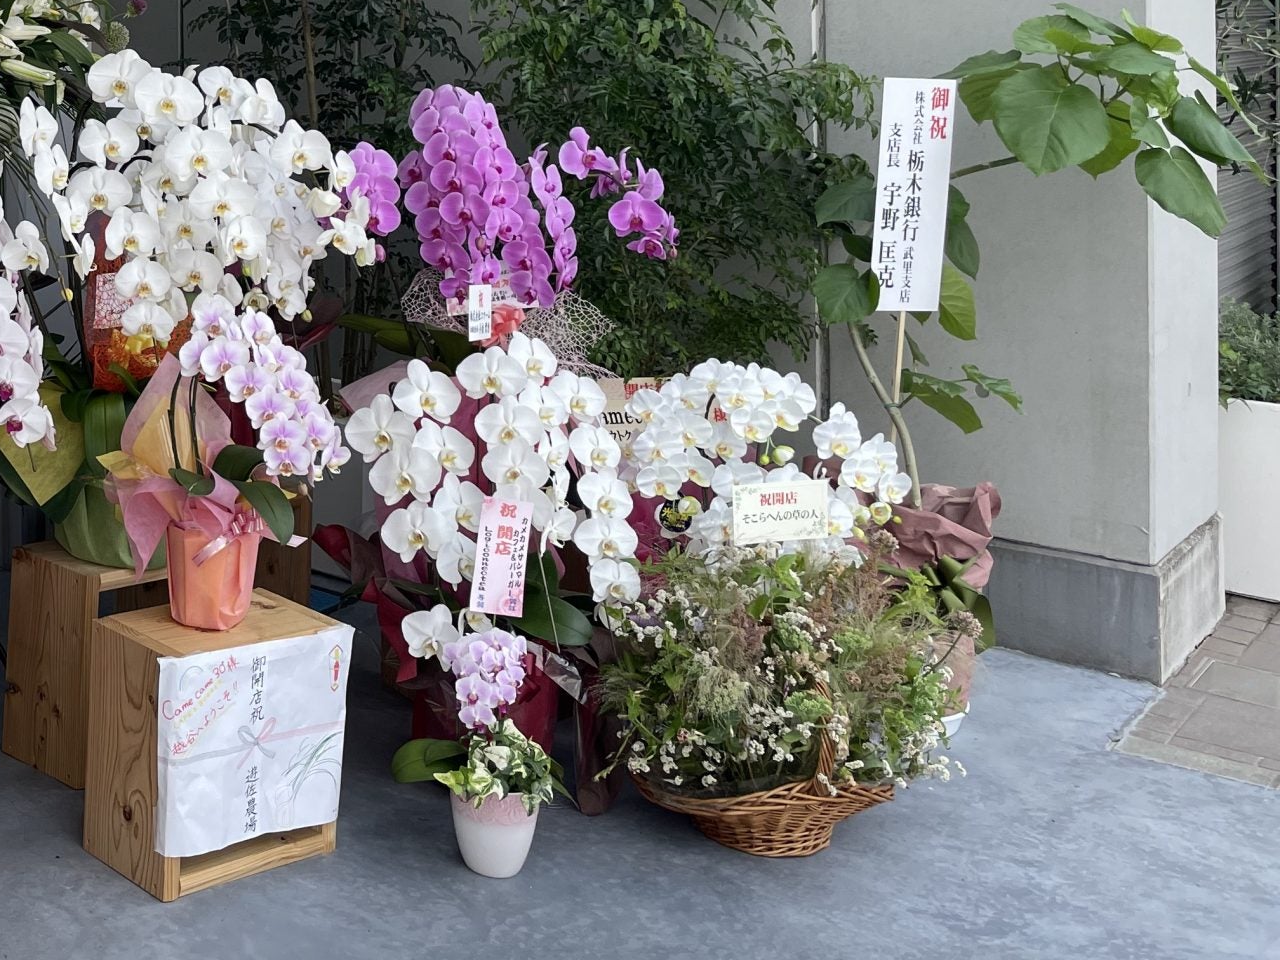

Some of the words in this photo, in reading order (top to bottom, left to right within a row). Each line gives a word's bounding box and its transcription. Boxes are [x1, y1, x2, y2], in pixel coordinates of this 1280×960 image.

[913, 91, 926, 144] 株式会社
[930, 87, 950, 139] 御祝
[886, 122, 903, 168] 支店長
[901, 149, 925, 242] 栃木銀行
[899, 246, 915, 303] 武里支店
[742, 508, 819, 524] そこらへんの草の人
[760, 491, 798, 507] 祝開店
[249, 655, 267, 726] 御開店祝
[244, 765, 260, 834] 遊佐農場
